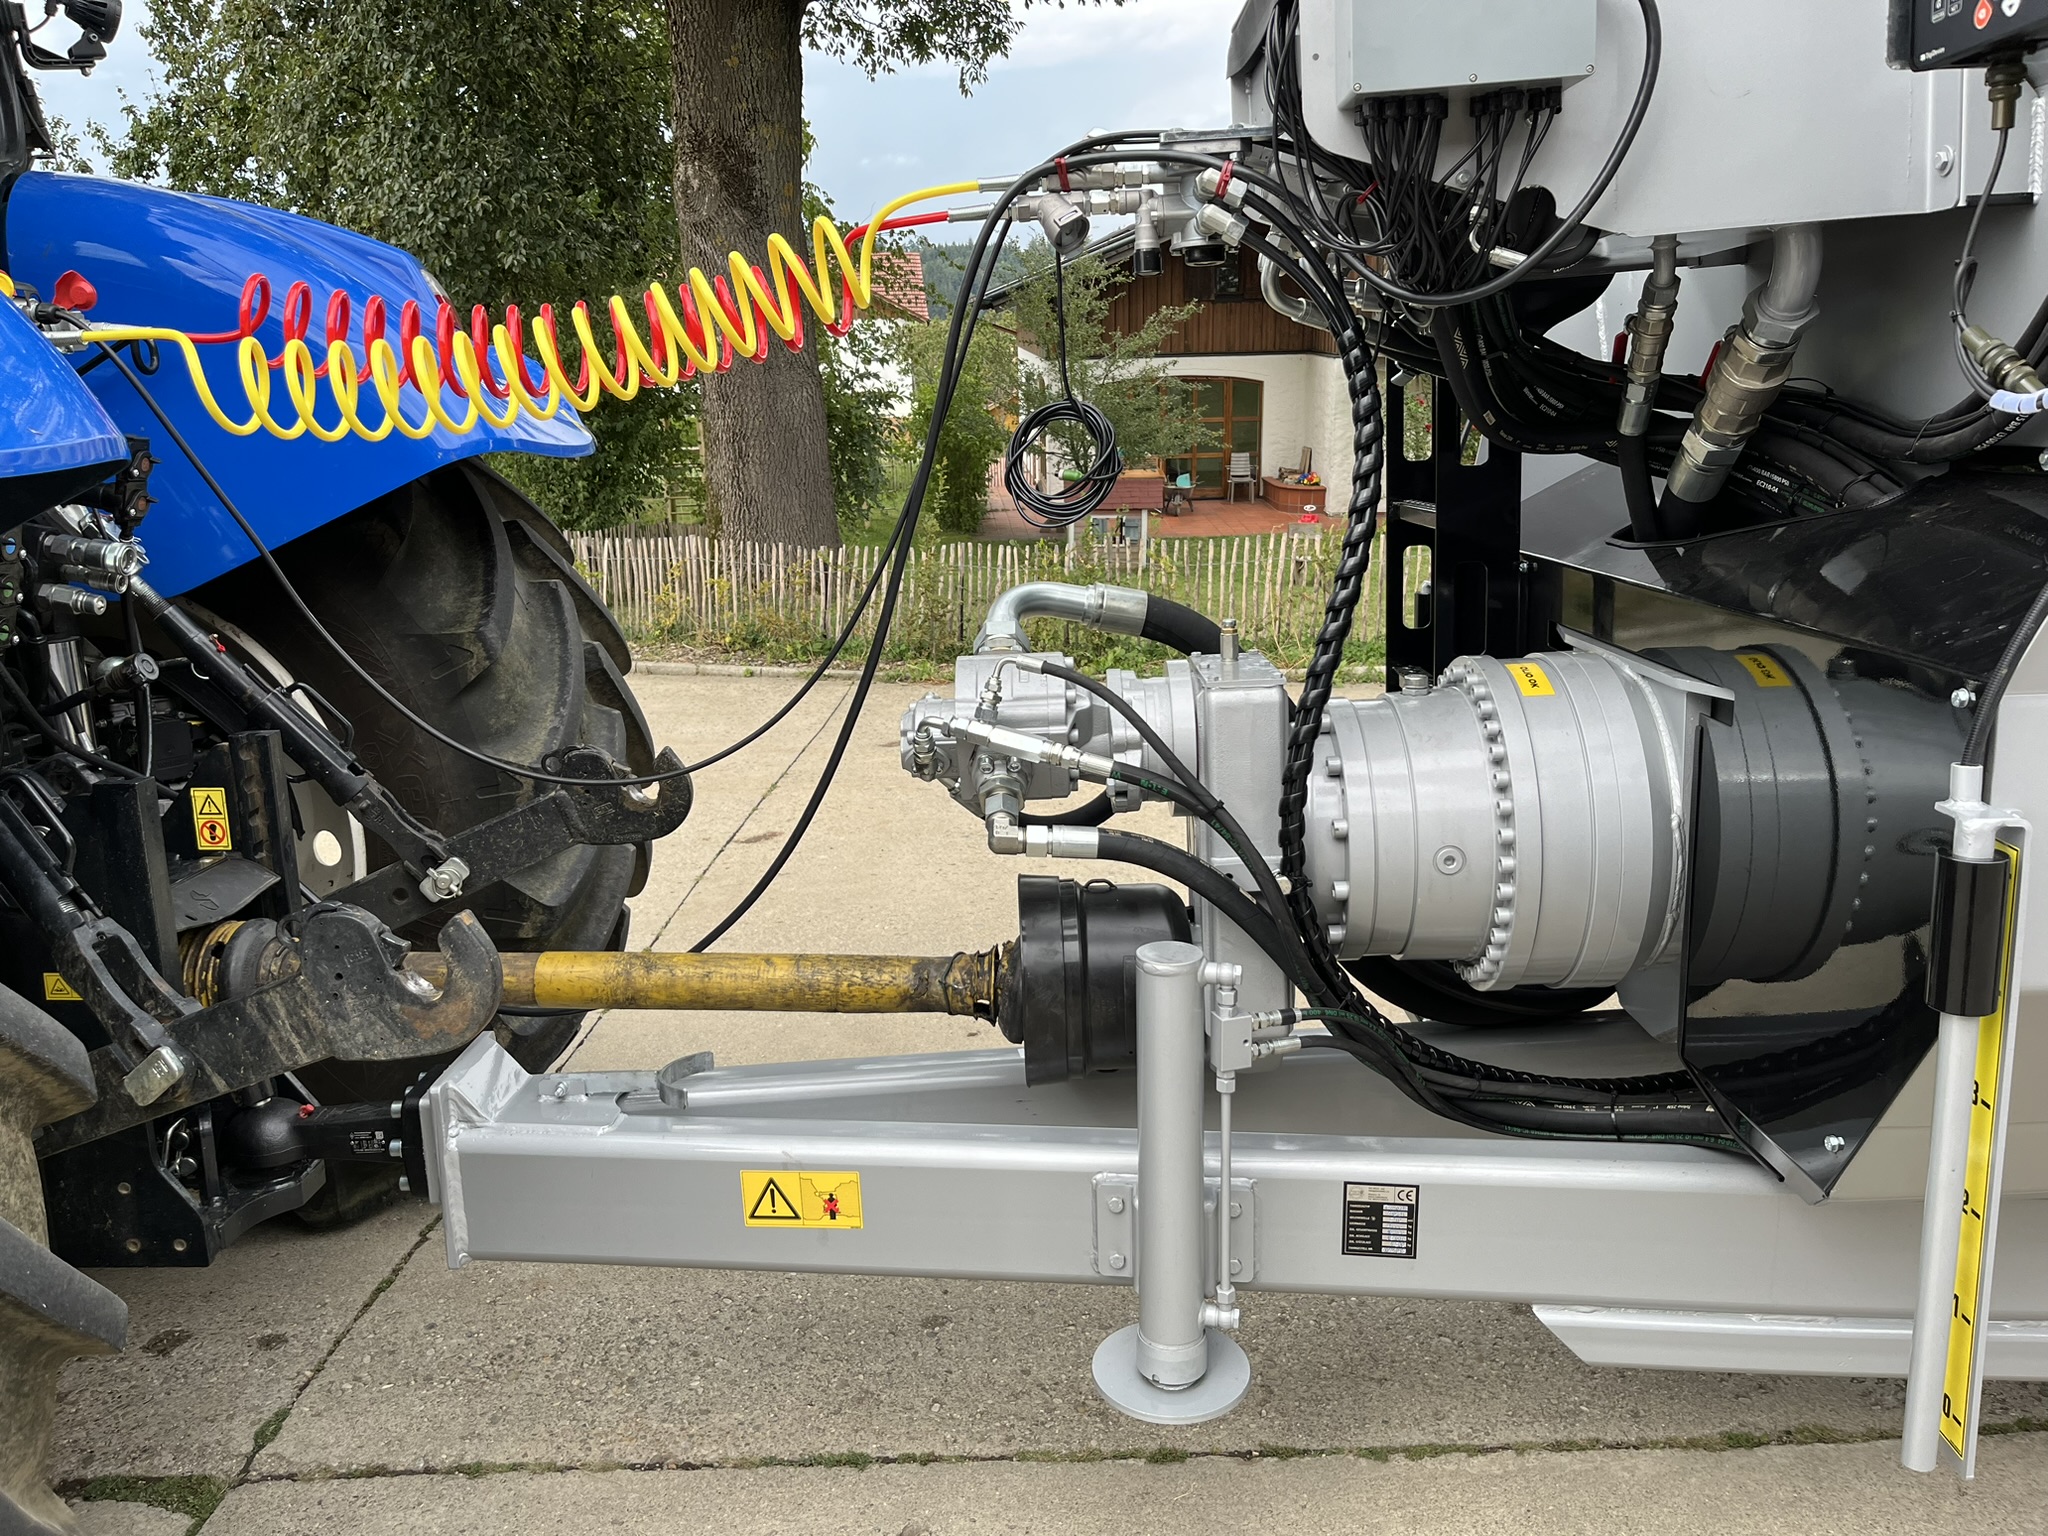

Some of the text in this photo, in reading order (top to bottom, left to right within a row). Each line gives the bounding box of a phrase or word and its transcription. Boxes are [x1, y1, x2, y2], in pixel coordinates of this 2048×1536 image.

[1756, 479, 1779, 494] EC210-04
[1528, 679, 1540, 689] OK
[1397, 1189, 1413, 1202] CE
[1952, 1293, 1959, 1319] 1
[1942, 1392, 1952, 1419] 0
